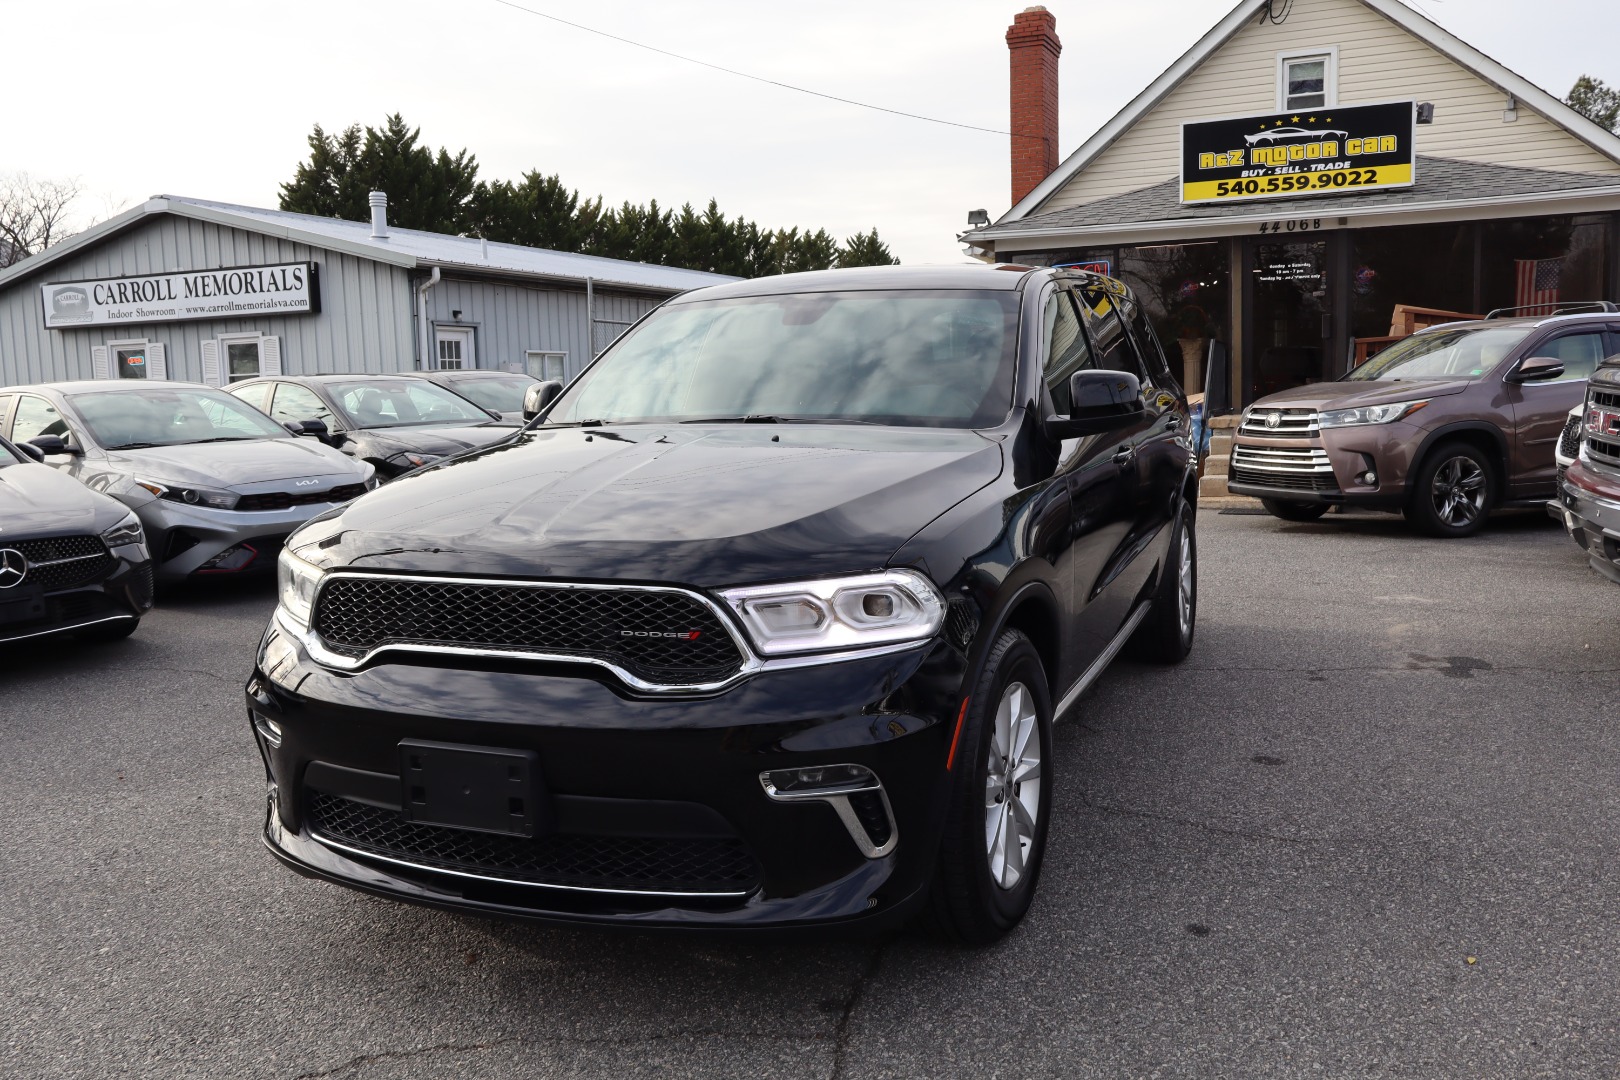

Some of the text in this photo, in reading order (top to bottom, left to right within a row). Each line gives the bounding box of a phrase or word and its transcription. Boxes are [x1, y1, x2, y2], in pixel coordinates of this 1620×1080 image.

[1199, 149, 1244, 169] A&Z
[1241, 161, 1351, 178] BUY SELL TRADE
[1216, 169, 1378, 196] 540.559.9022
[1259, 218, 1321, 234] 4406B
[93, 267, 304, 306] CARROLL MEMORIALS
[107, 298, 308, 319] Indoor Showroom www.carrollmemorialsva.com
[620, 630, 691, 639] DODGE
